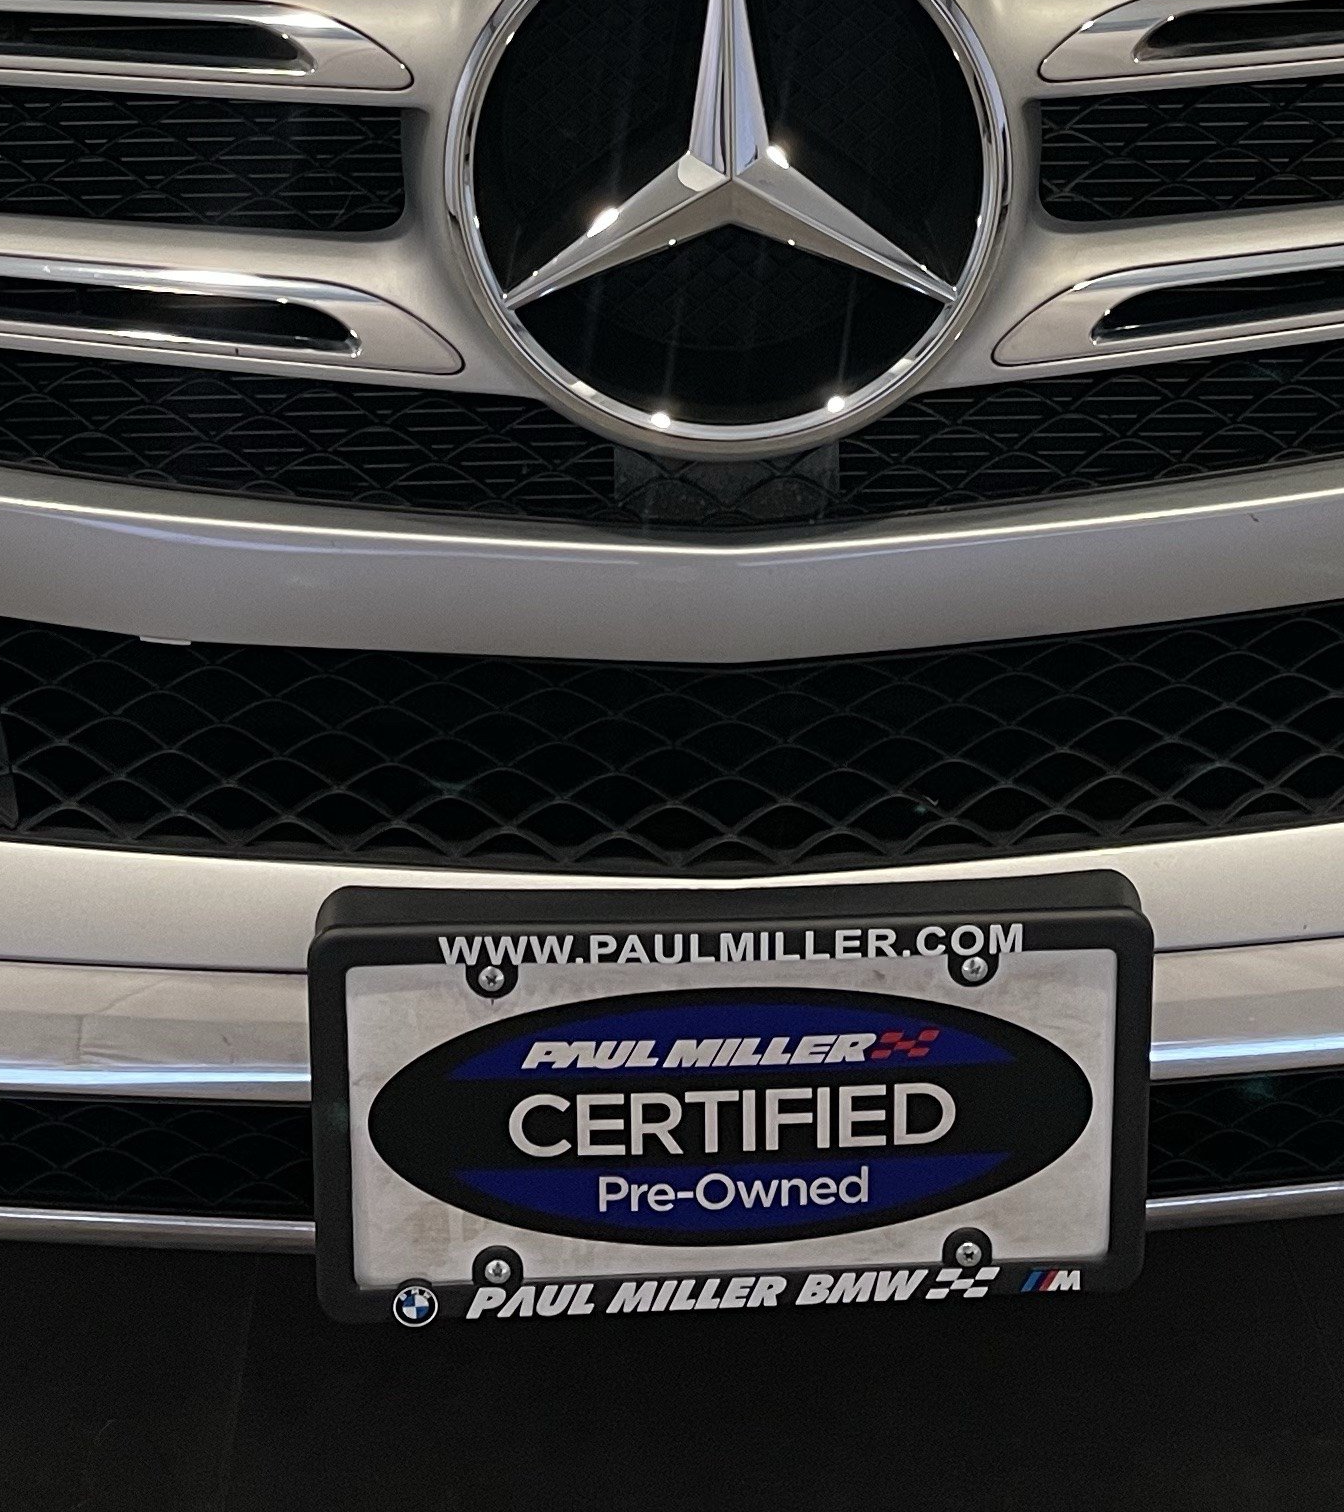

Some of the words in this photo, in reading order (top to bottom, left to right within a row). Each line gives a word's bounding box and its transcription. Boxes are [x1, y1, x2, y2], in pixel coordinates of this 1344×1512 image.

[437, 923, 1023, 966] WWW.PAULMILLER.COM
[520, 1039, 659, 1070] PAUL
[661, 1032, 878, 1068] MILLER
[508, 1082, 957, 1158] CERTIFIED
[597, 1165, 869, 1213] Pre-Owned
[465, 1283, 596, 1320] PAUL
[605, 1274, 788, 1315] MILLER
[794, 1268, 929, 1306] BMW
